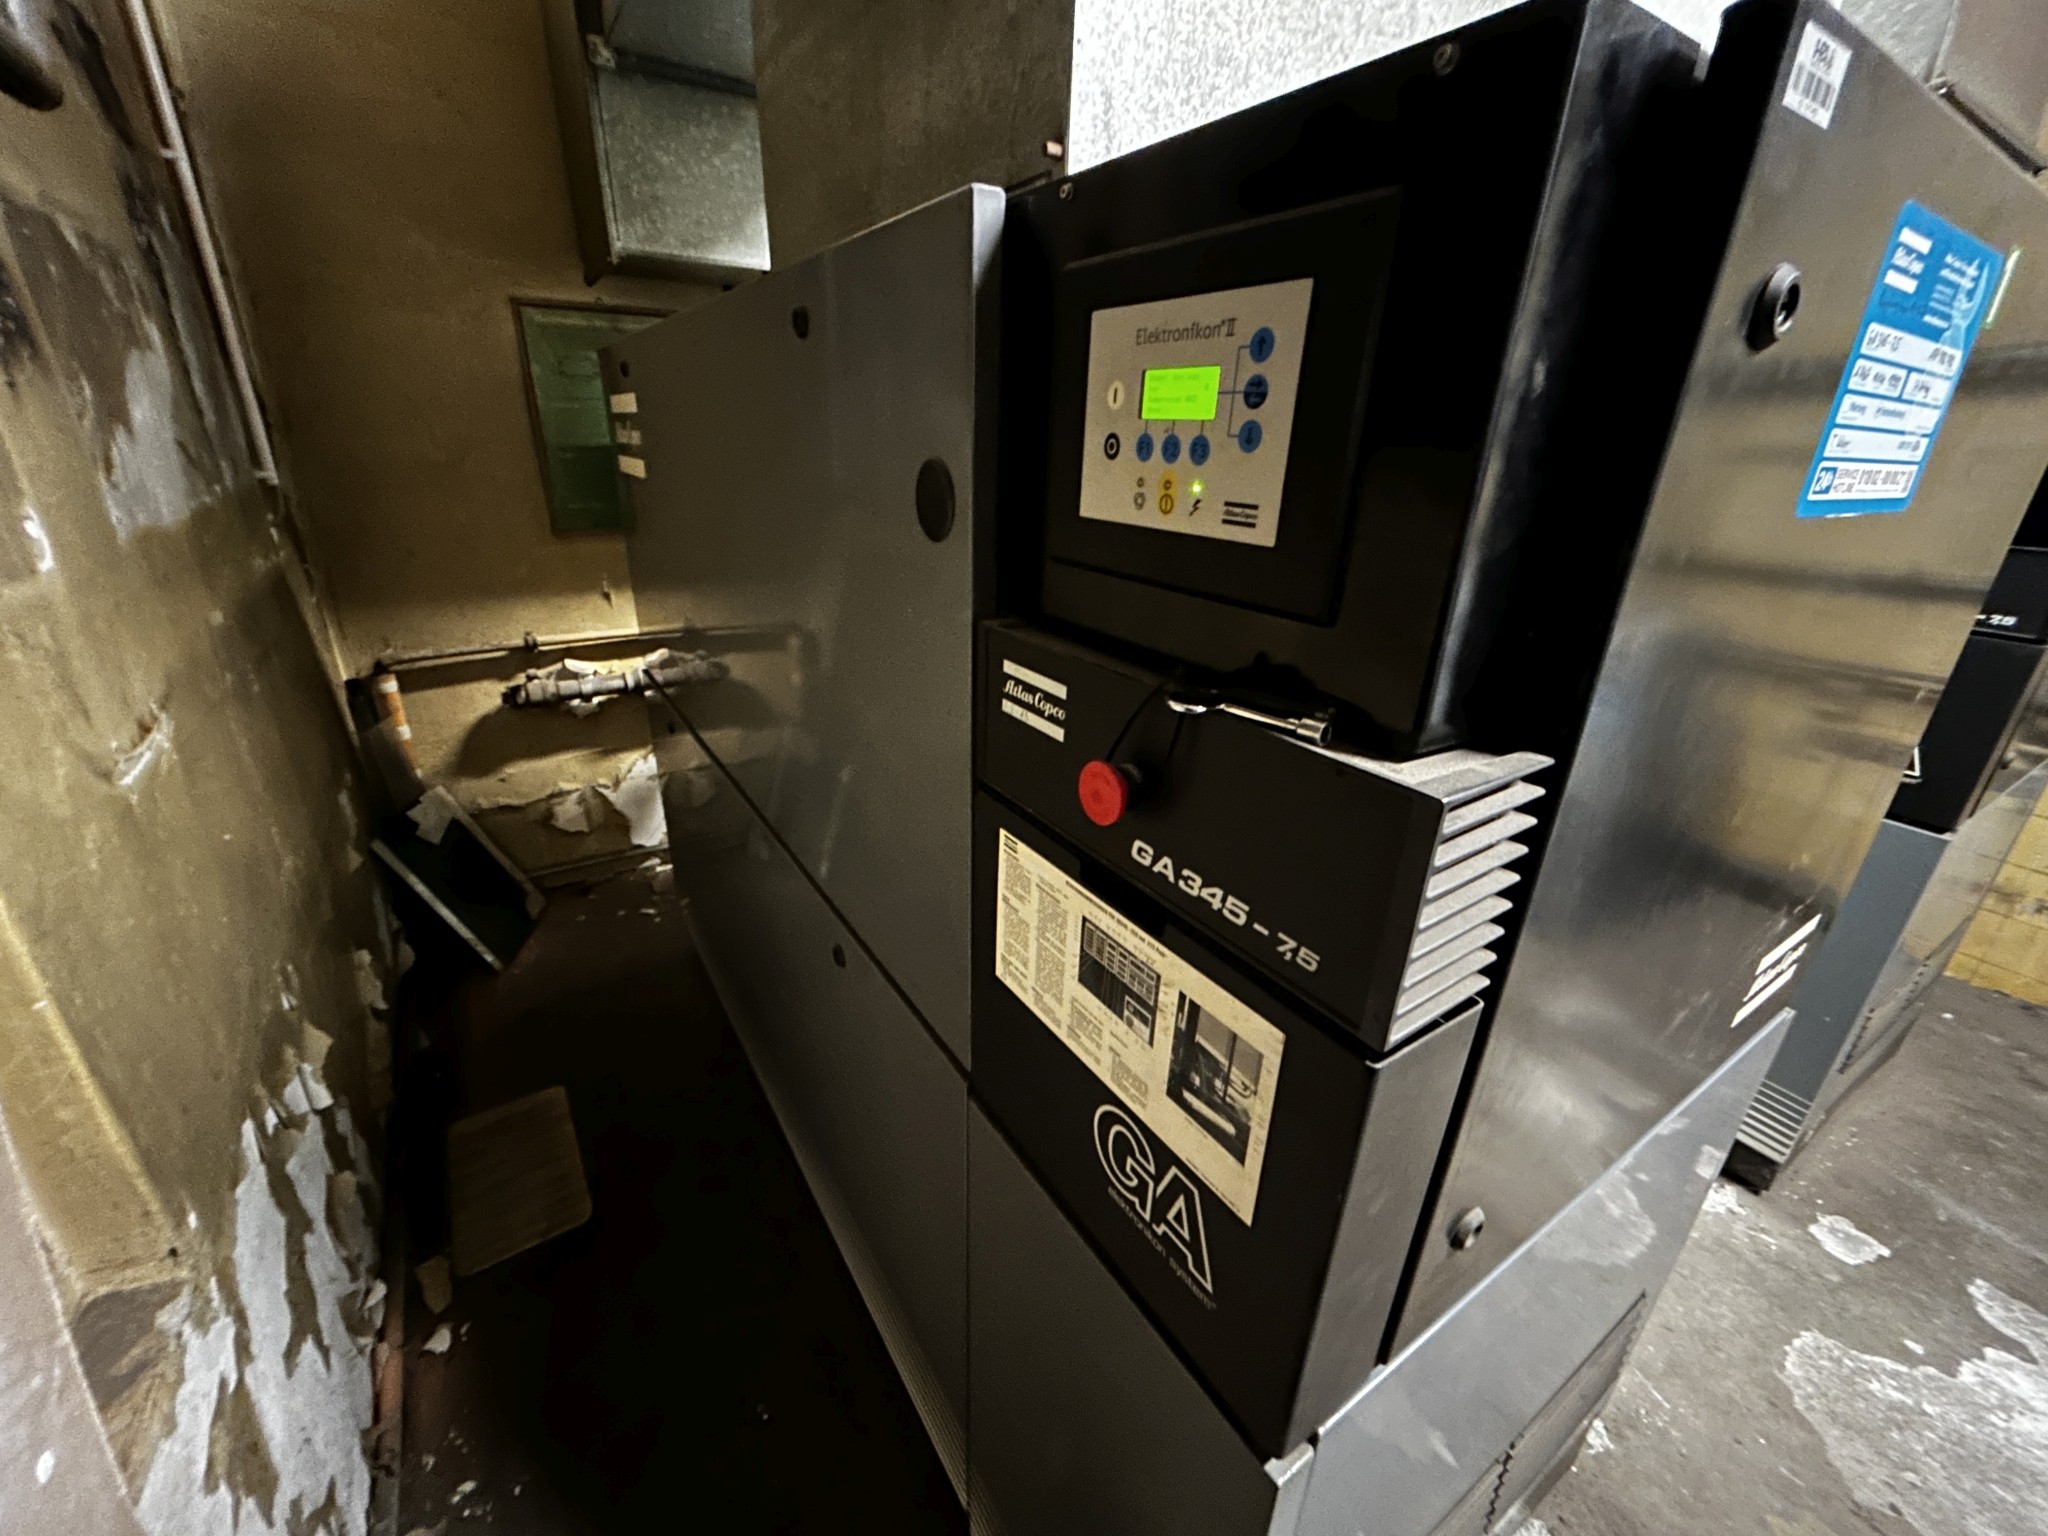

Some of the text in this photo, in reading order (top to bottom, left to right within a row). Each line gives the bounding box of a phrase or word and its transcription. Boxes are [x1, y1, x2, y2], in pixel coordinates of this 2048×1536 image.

[1003, 679, 1066, 720] Atlas Copco
[1093, 1104, 1214, 1295] GA
